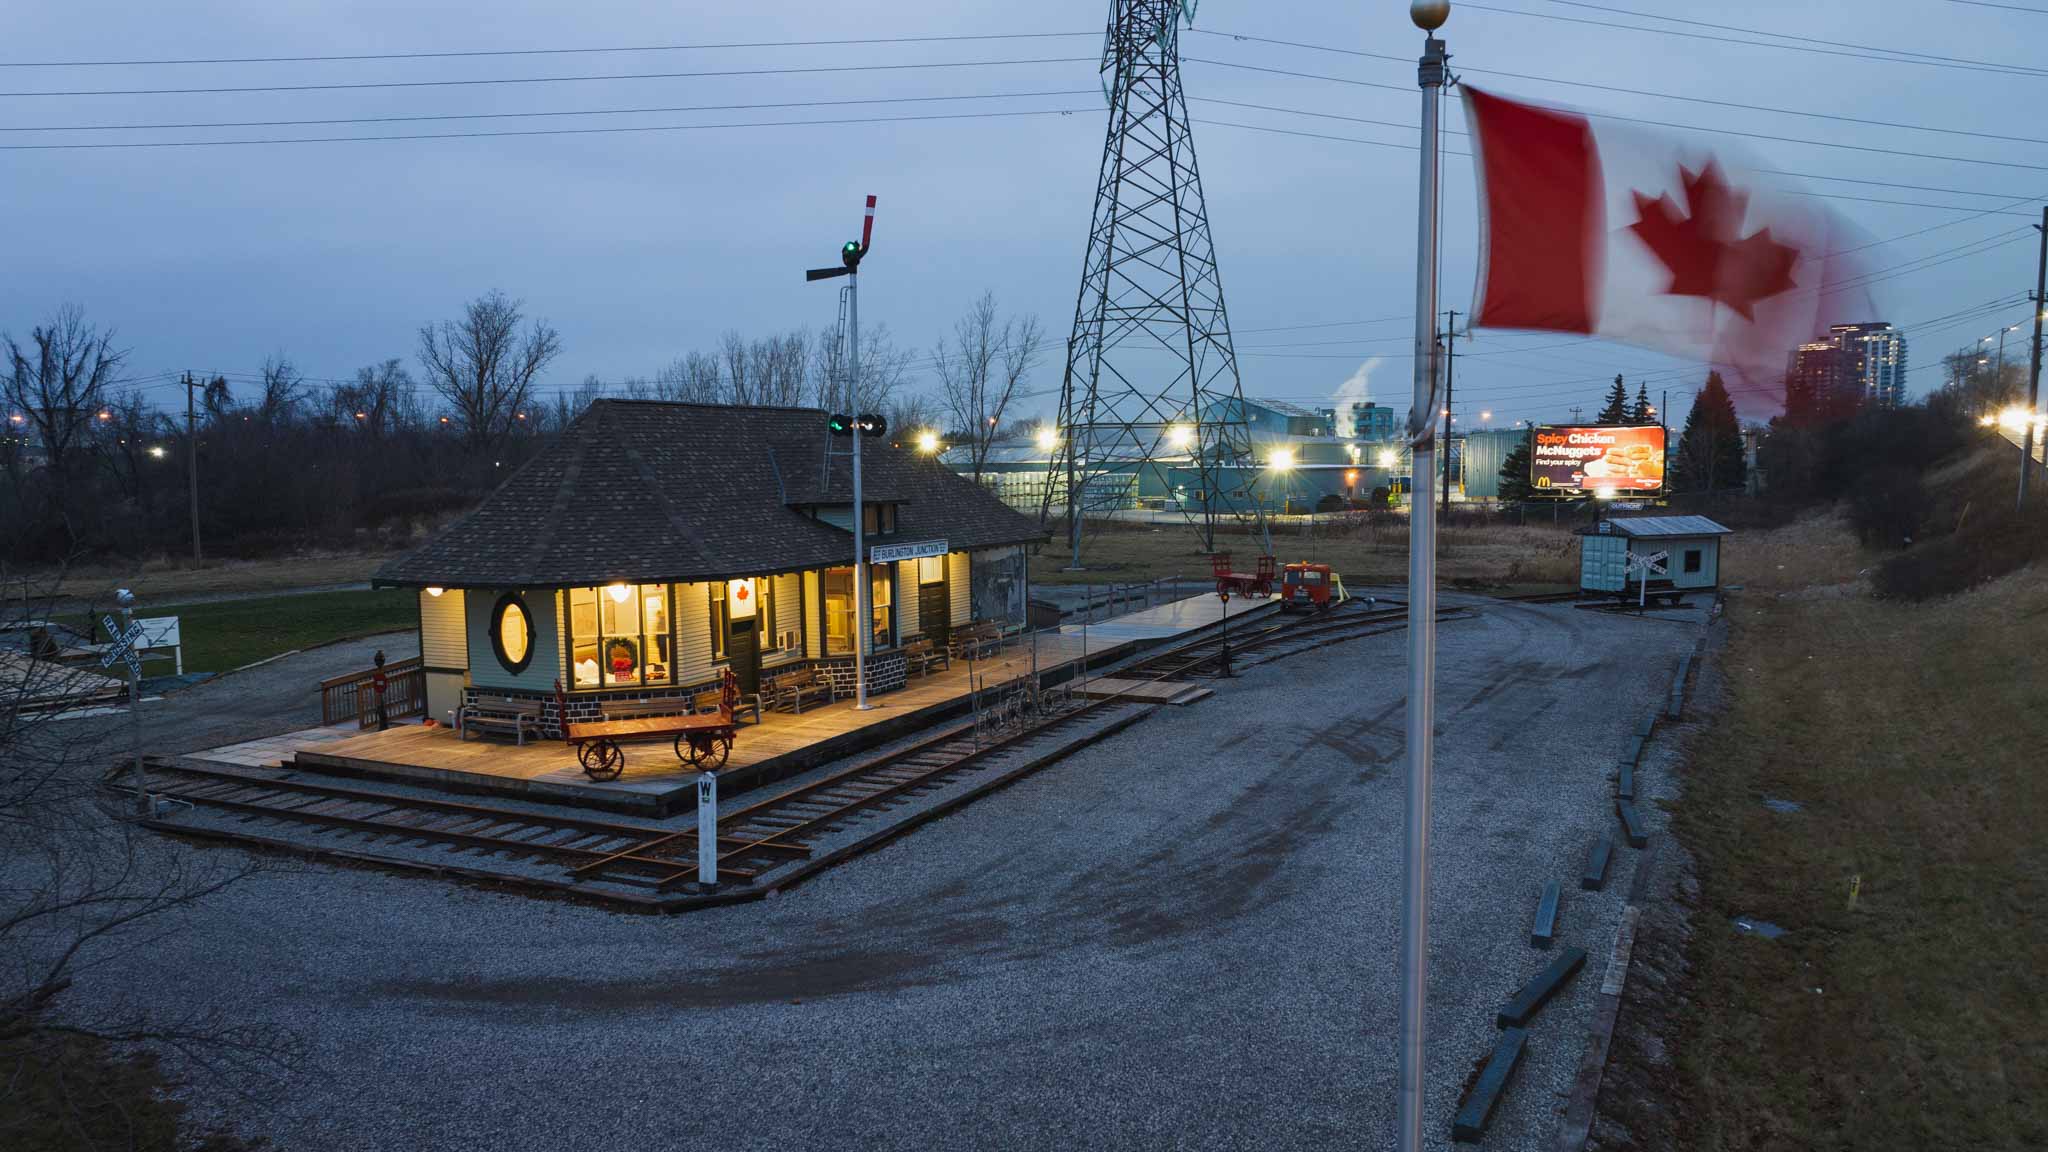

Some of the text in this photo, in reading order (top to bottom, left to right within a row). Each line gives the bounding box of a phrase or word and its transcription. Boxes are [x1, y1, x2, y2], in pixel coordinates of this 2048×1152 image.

[1537, 433, 1616, 446] Spicy Chicken
[1536, 446, 1602, 458] McNuggets
[1565, 459, 1581, 467] spicy
[882, 546, 913, 559] BURLINGTON
[914, 543, 939, 555] JUNCTION
[104, 616, 121, 640] RAIL
[700, 782, 711, 796] W
